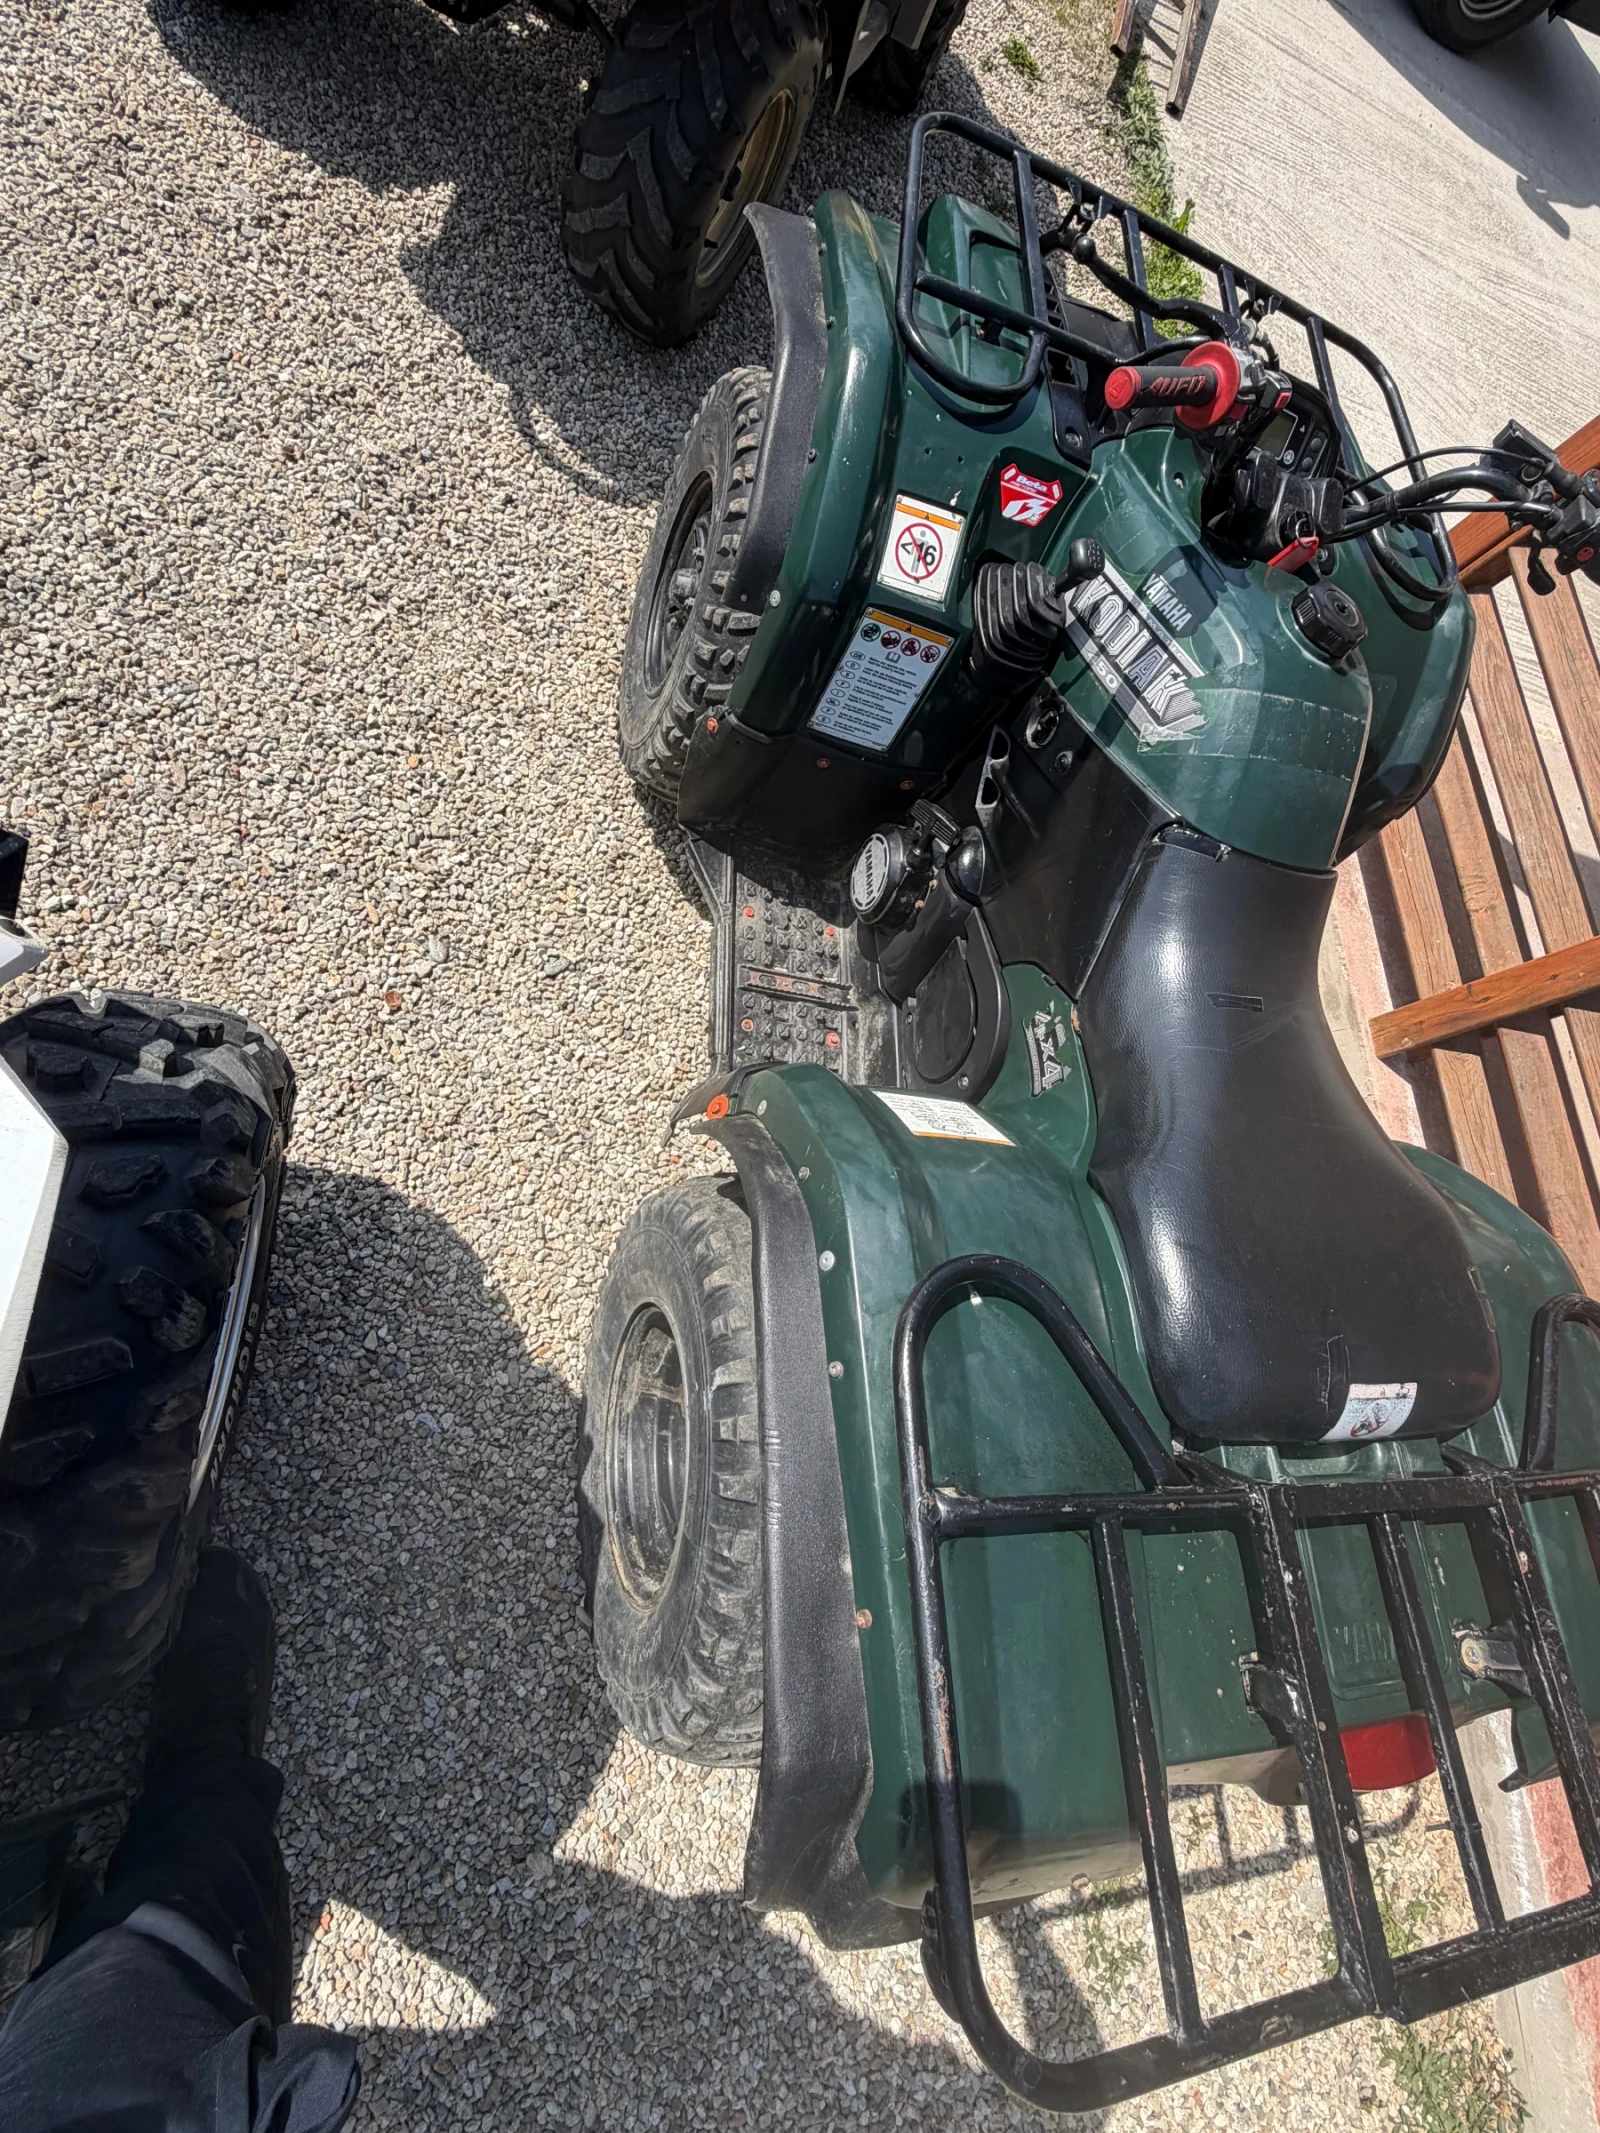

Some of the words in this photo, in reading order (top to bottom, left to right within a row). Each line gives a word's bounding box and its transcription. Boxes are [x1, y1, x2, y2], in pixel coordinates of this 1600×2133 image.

[1016, 475, 1048, 492] Beta
[1142, 573, 1193, 632] YAMAHA
[1073, 574, 1190, 720] KODIAK
[1087, 650, 1119, 690] 450
[865, 844, 875, 900] YAMAHA
[209, 1302, 259, 1491] BIGHORN
